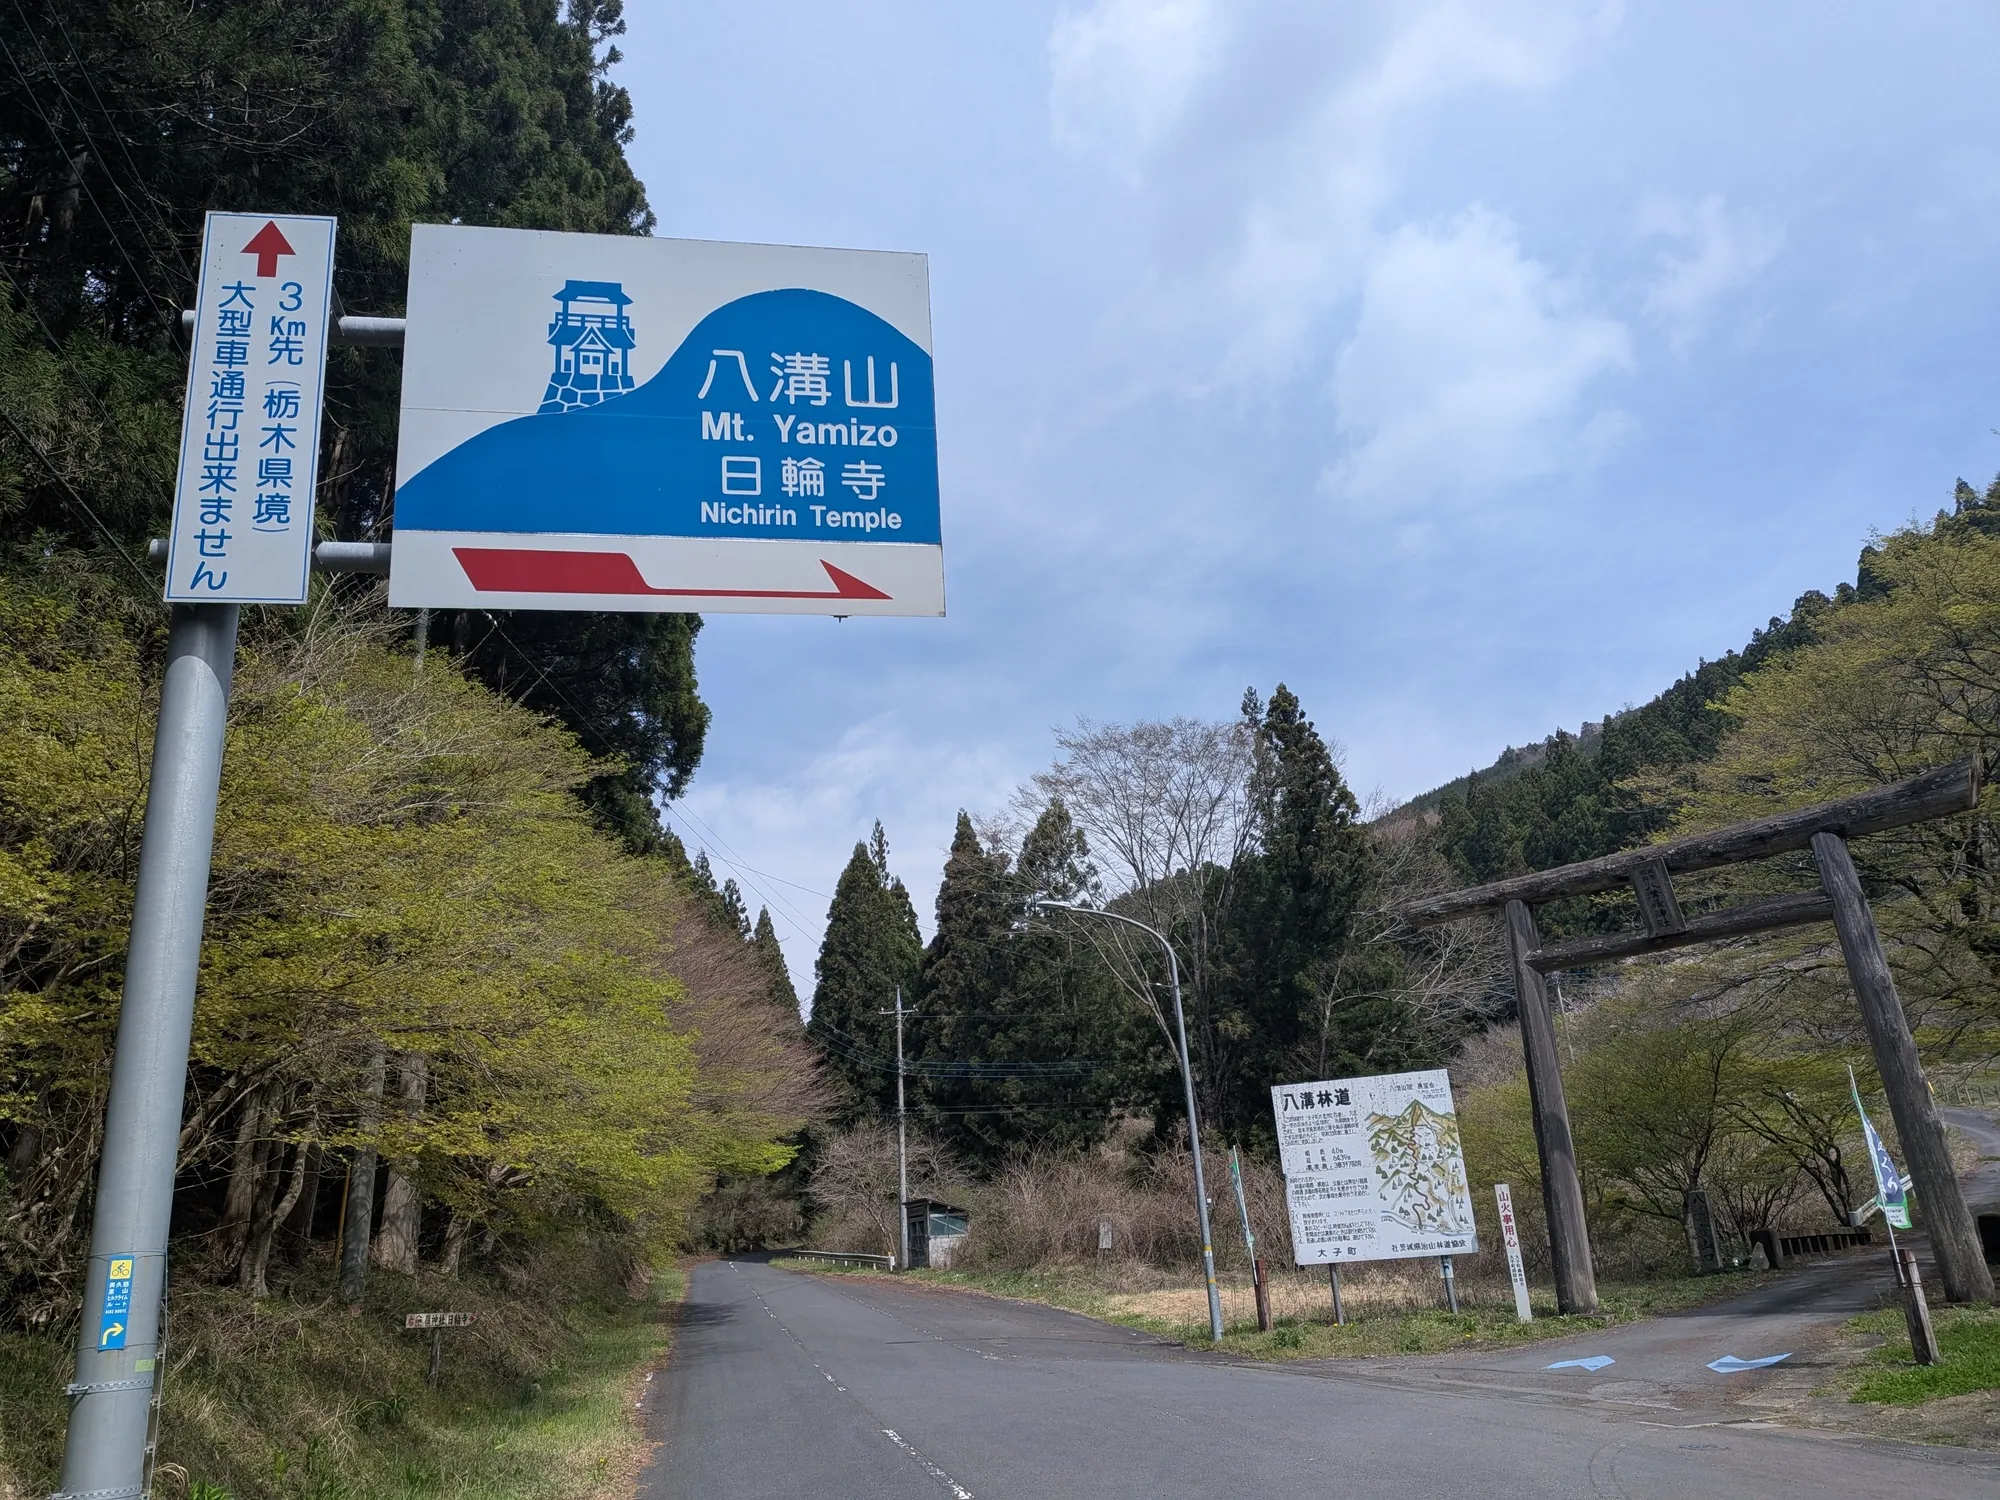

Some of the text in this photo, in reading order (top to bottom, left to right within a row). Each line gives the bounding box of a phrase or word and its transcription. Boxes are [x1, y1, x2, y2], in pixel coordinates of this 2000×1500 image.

[698, 349, 899, 408] 八溝山
[190, 280, 257, 590] 大型車通行出来ません
[702, 411, 898, 447] Mt. Yamizo
[722, 456, 886, 500] 日輪寺
[701, 501, 902, 532] Nichirin Temple
[1283, 1088, 1351, 1111] 八溝林道
[1498, 1191, 1518, 1248] 山火事用心
[1317, 1246, 1357, 1258] 大子町
